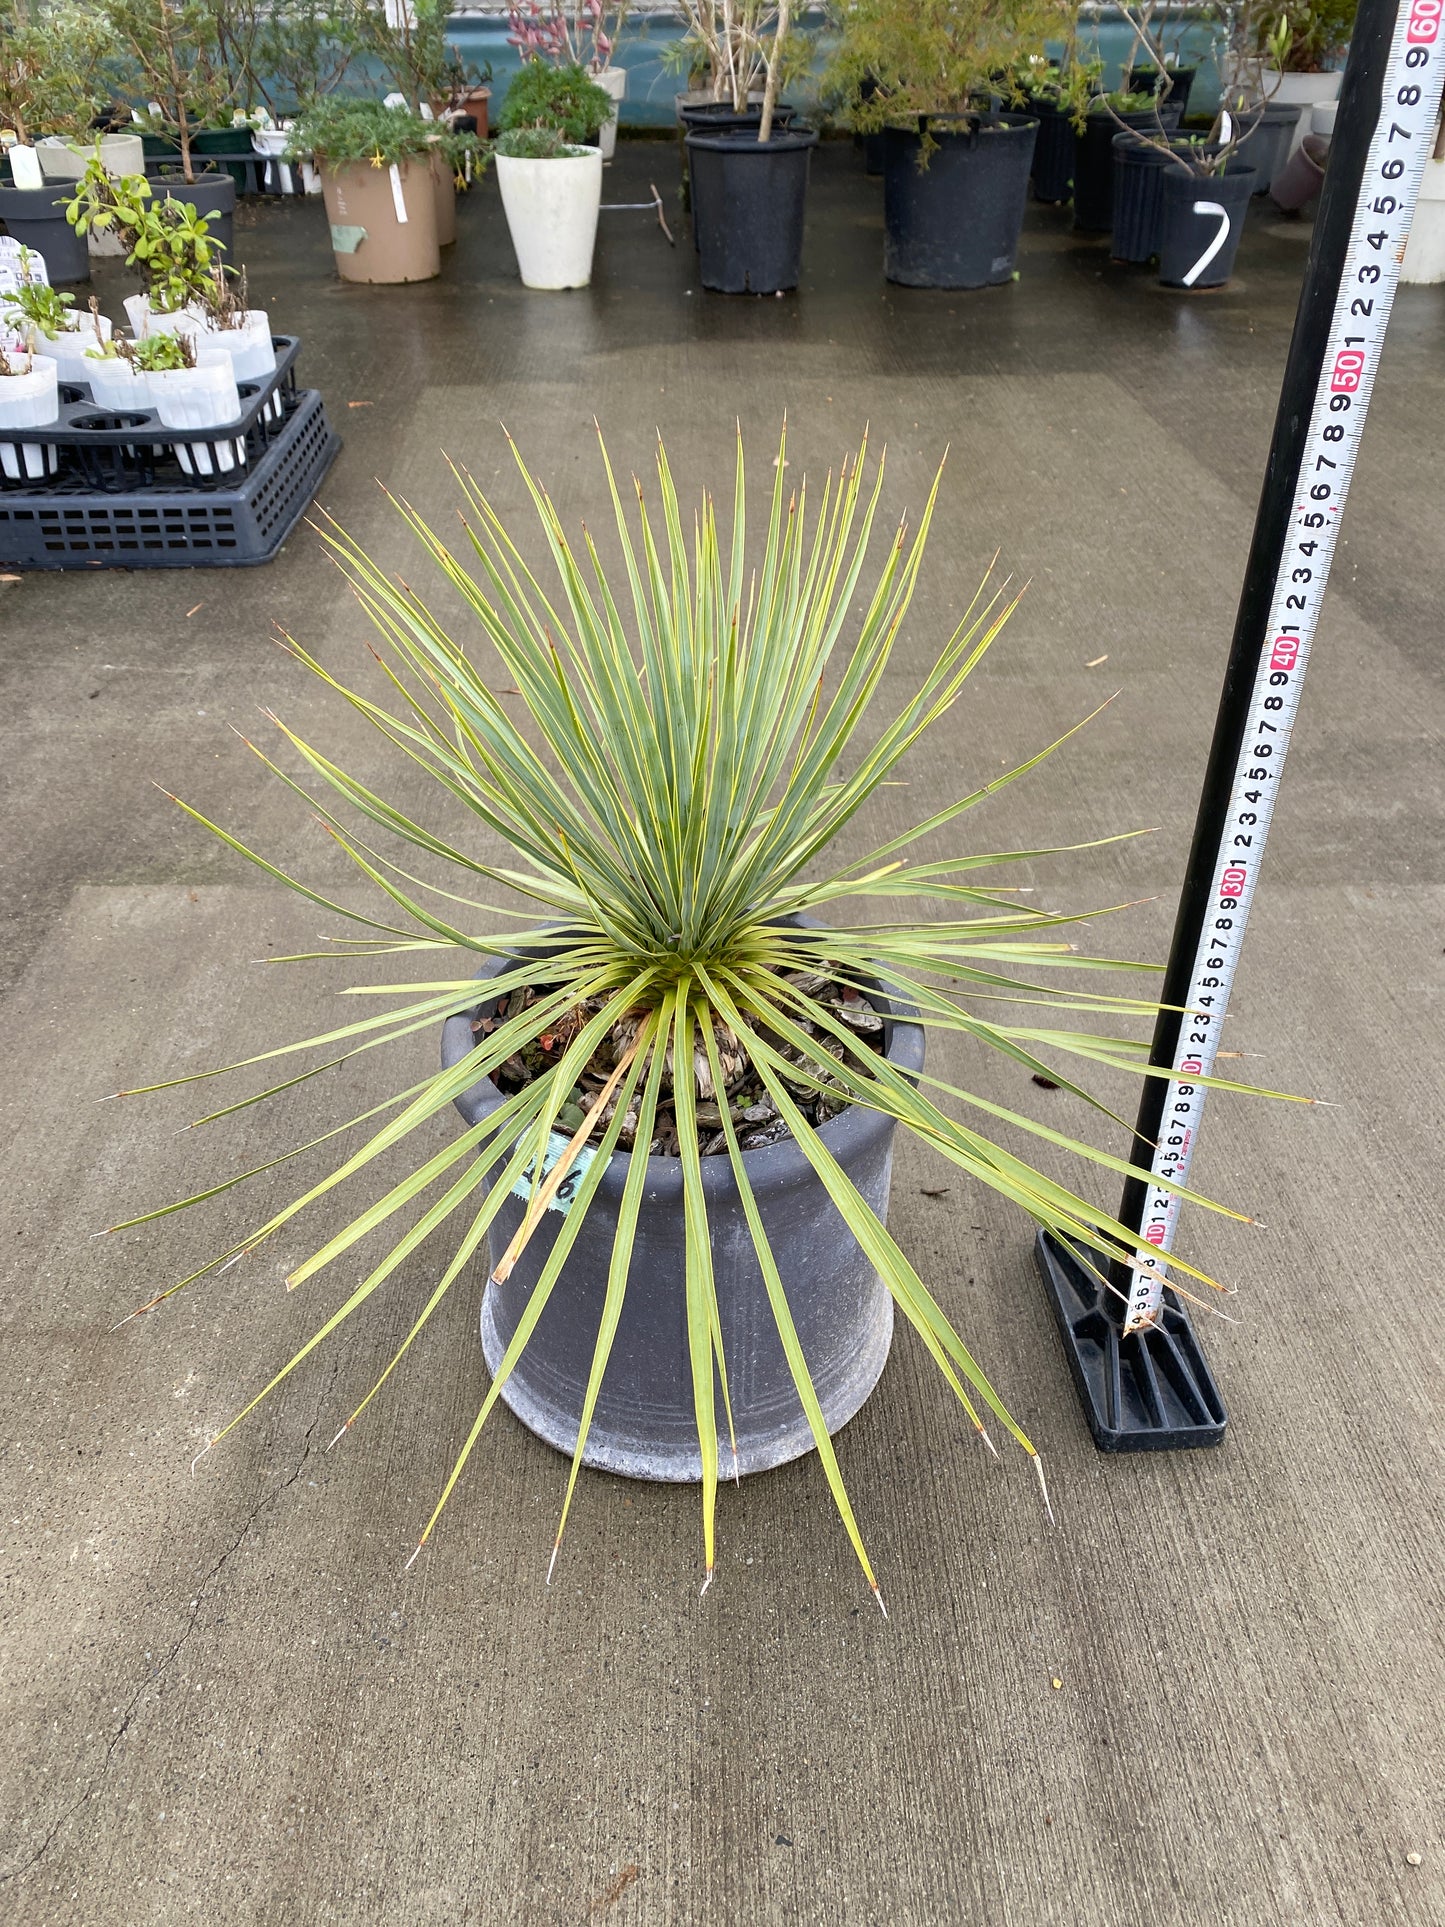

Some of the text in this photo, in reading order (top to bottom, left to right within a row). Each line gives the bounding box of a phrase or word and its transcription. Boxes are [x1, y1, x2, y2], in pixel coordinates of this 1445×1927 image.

[1411, 0, 1440, 36] 60
[1406, 47, 1430, 68] 9
[1398, 85, 1422, 106] 8
[1388, 123, 1412, 143] 7
[1381, 159, 1405, 180] 6
[1373, 195, 1396, 214] 5
[1367, 230, 1389, 250] 4
[1358, 265, 1381, 284] 3
[1351, 298, 1373, 317] 2
[1334, 356, 1362, 386] 50
[1330, 394, 1350, 412] 9
[1323, 425, 1344, 442] 8
[1316, 455, 1336, 471] 7
[1310, 484, 1331, 500] 6
[1304, 513, 1324, 528] 5
[1299, 540, 1318, 557] 4
[1292, 568, 1312, 584] 3
[1286, 595, 1306, 610] 2
[1274, 640, 1297, 666] 40
[1270, 672, 1288, 686] 9
[1264, 696, 1283, 710] 8
[1259, 721, 1277, 734] 7
[1254, 744, 1272, 758] 6
[1248, 767, 1268, 781] 5
[1244, 790, 1262, 804] 4
[1238, 812, 1258, 826] 3
[1233, 834, 1253, 848] 2
[1223, 872, 1246, 893] 30
[1219, 897, 1238, 911] 9
[1215, 917, 1233, 931] 8
[1210, 937, 1229, 950] 7
[1206, 957, 1224, 969] 6
[1198, 995, 1216, 1008] 4
[1193, 1014, 1212, 1026] 3
[1189, 1032, 1208, 1044] 2
[1146, 1227, 1163, 1241] 10
